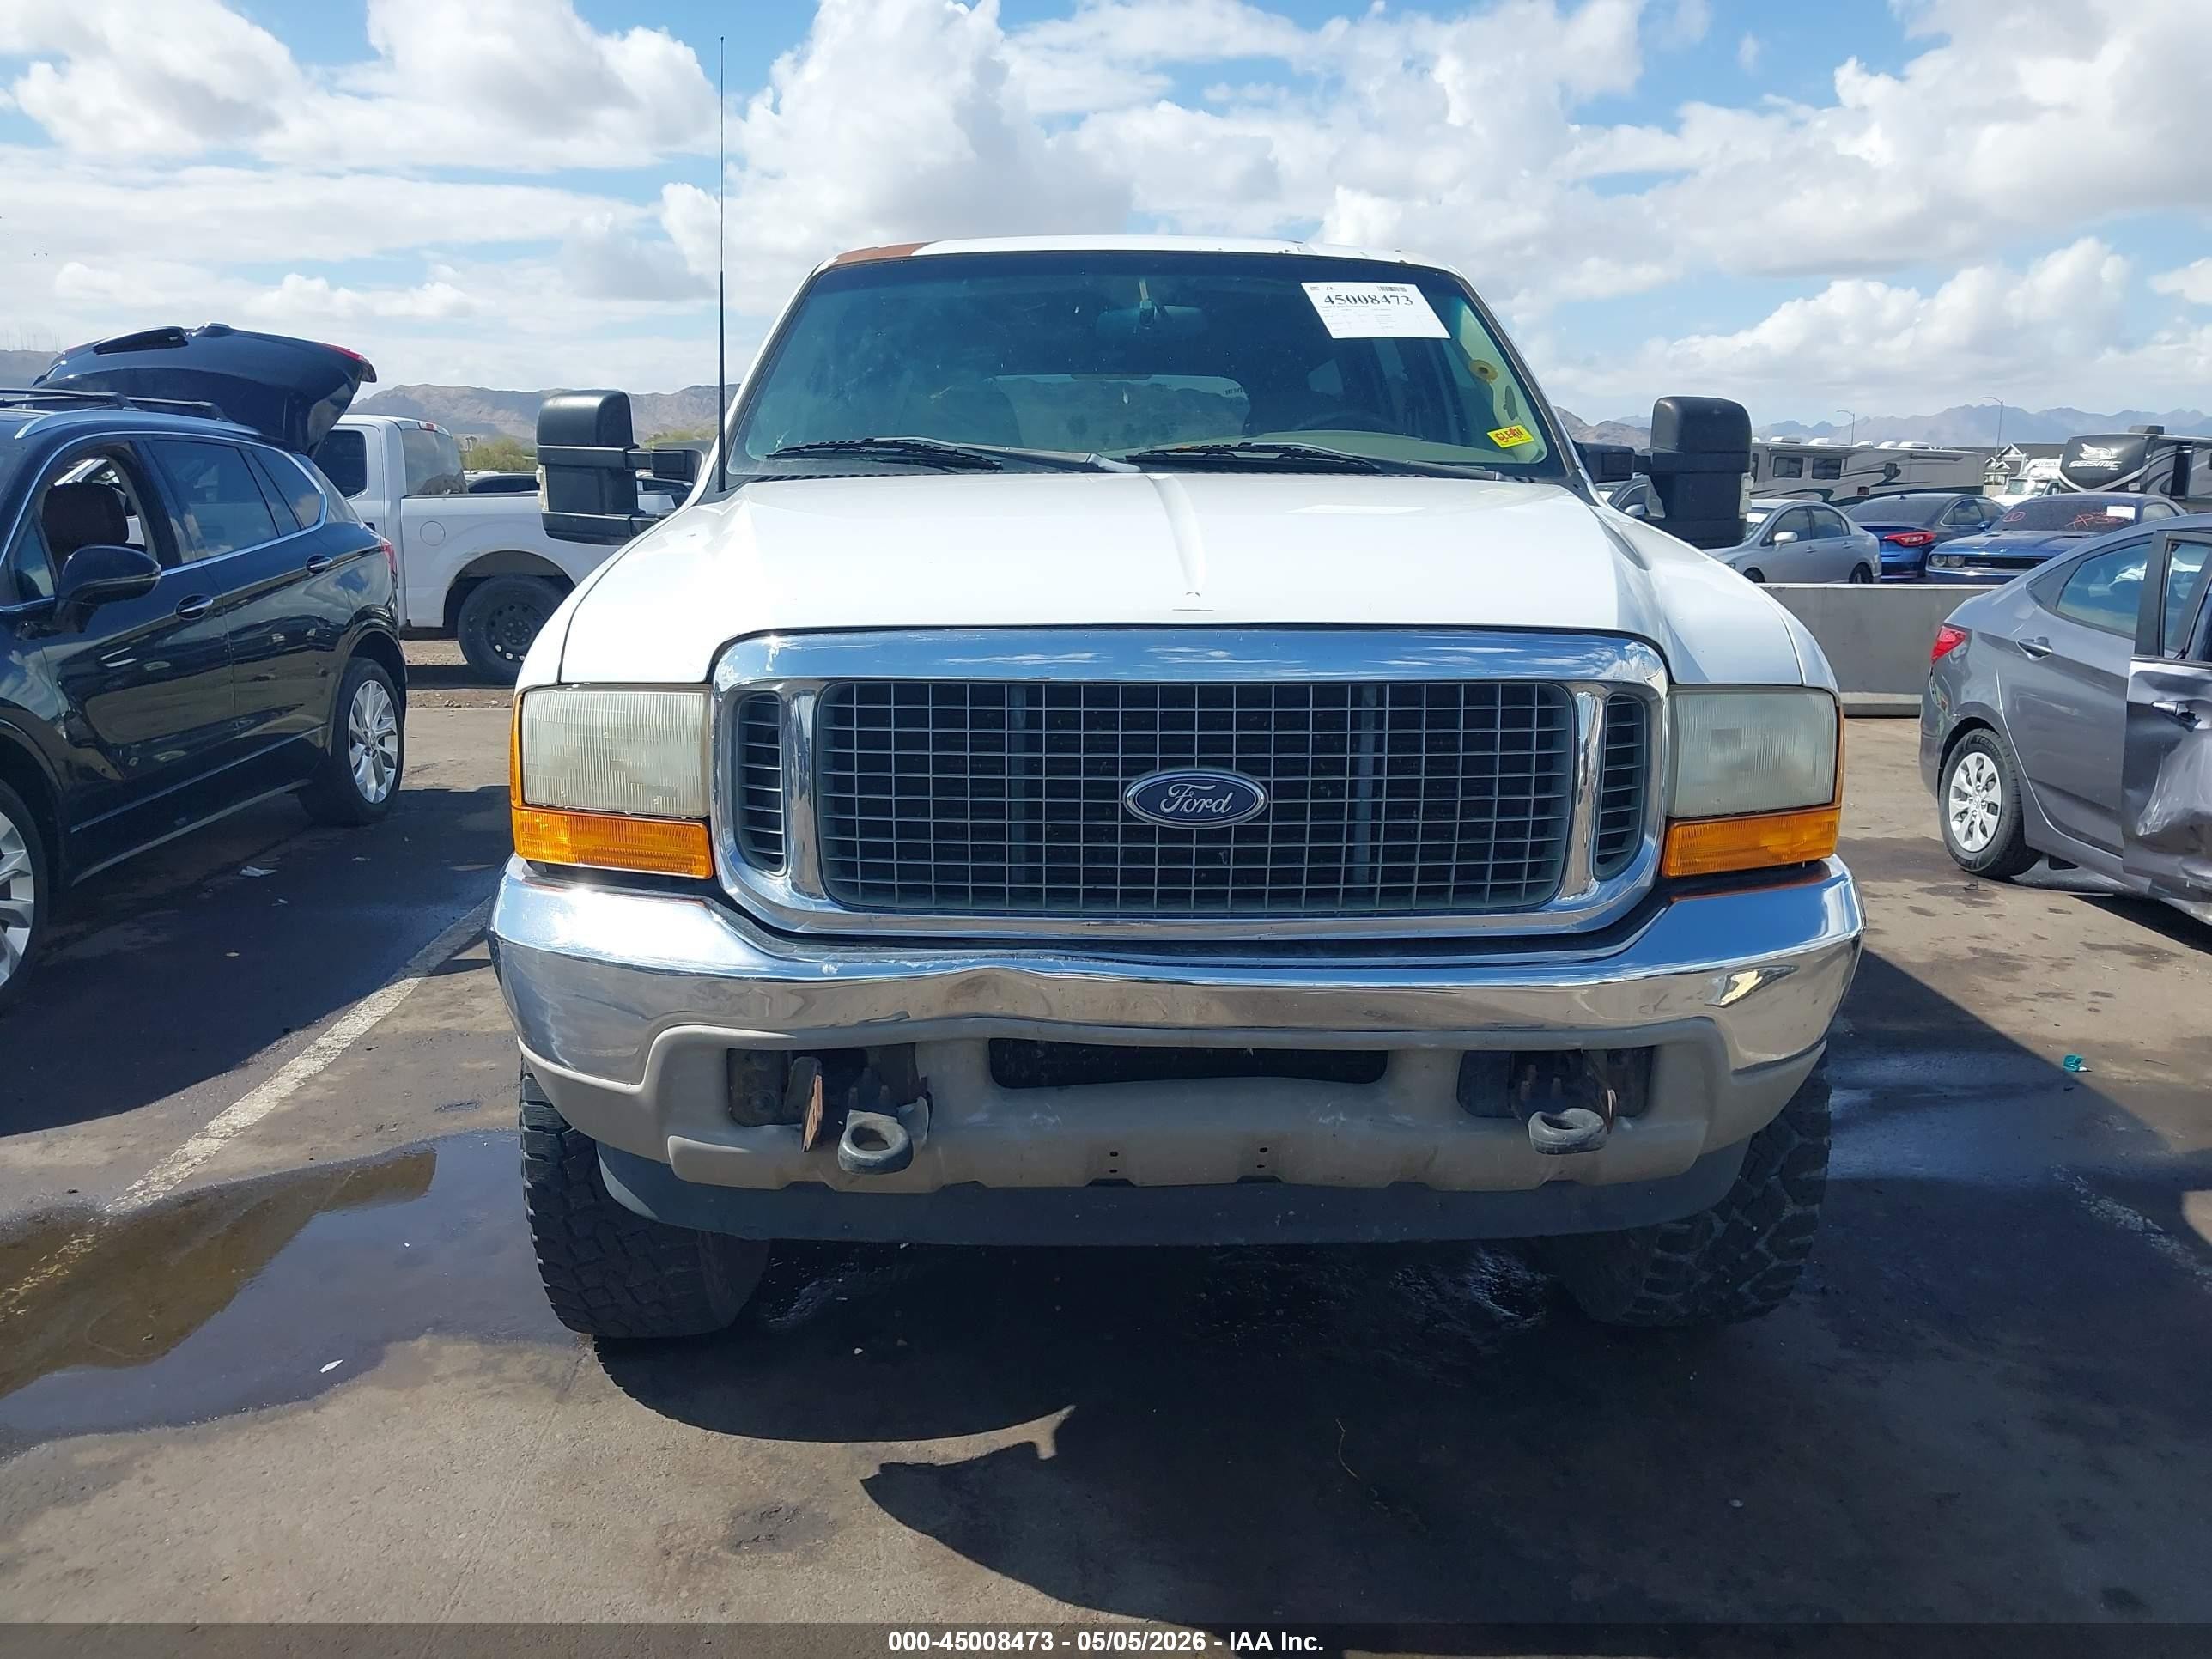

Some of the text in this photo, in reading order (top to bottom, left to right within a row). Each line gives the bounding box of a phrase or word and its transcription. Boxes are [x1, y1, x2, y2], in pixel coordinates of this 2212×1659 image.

[1323, 294, 1413, 306] 45008473
[2069, 459, 2122, 468] SEISMIC
[1159, 783, 1236, 814] Ford
